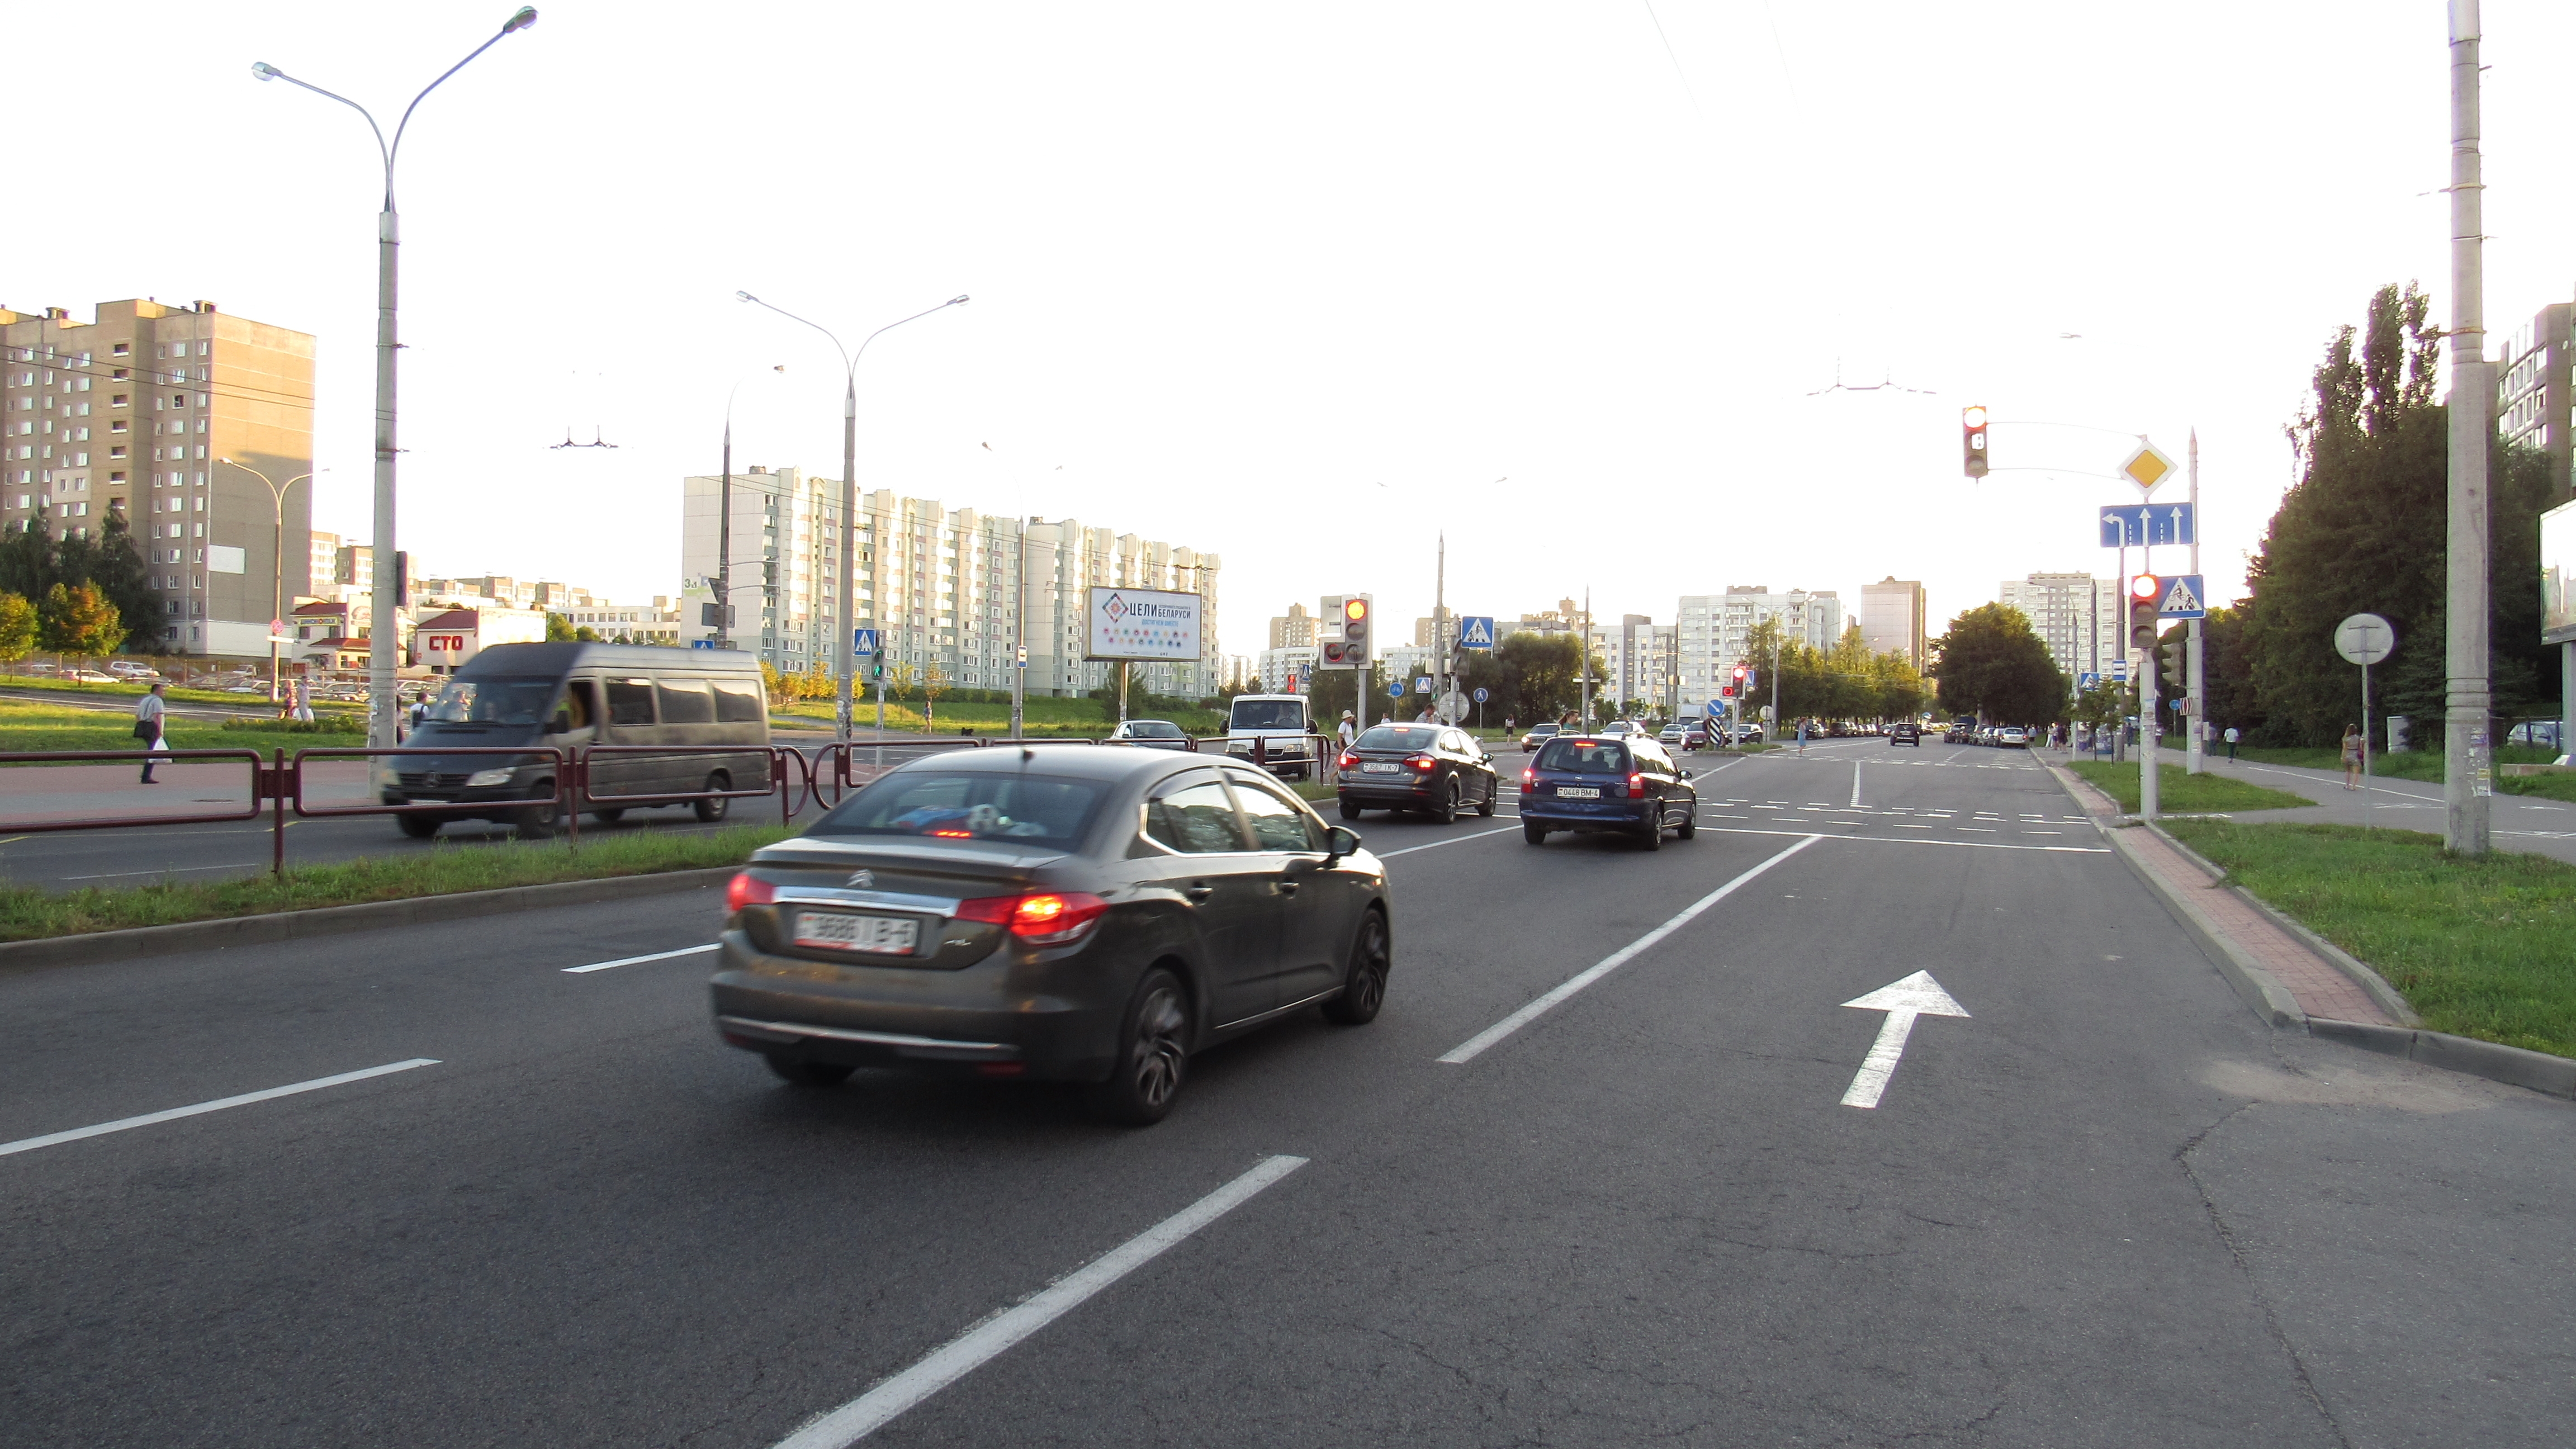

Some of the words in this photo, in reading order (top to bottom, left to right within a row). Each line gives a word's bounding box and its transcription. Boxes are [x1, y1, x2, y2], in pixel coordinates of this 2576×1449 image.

[1130, 603, 1157, 617] ЦЕЛИ
[1158, 608, 1191, 619] БЕЛАРУСИ
[429, 636, 463, 650] СТО
